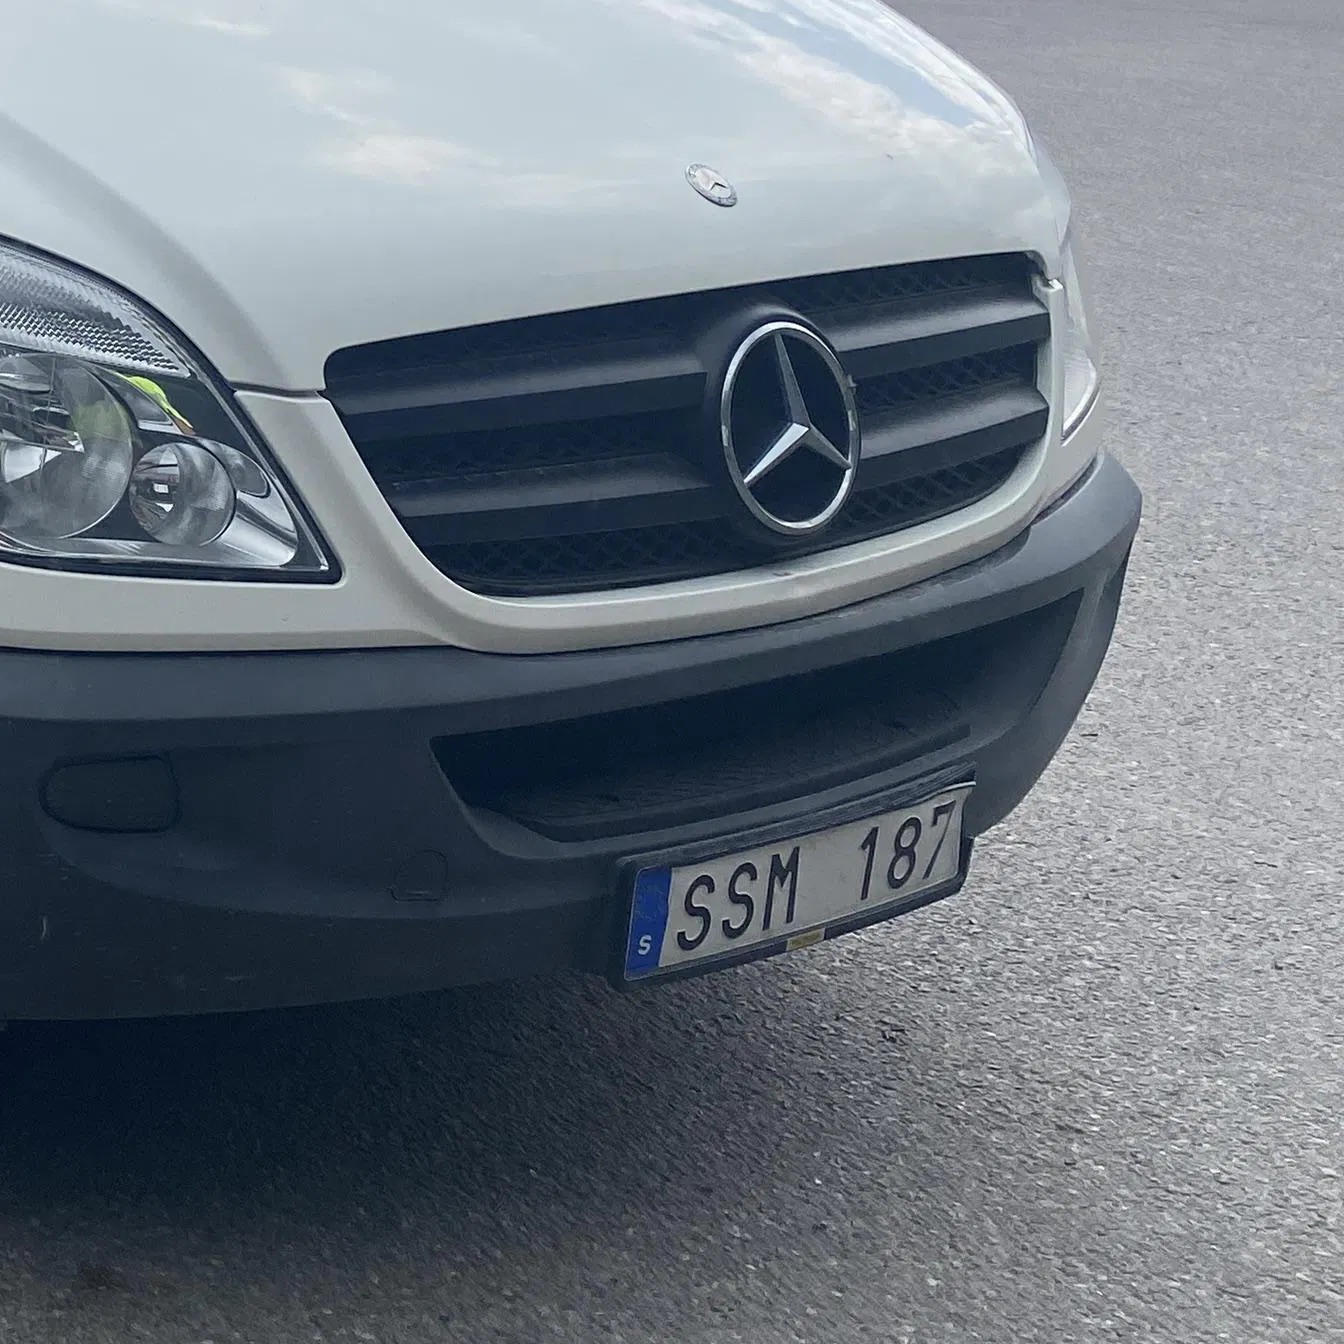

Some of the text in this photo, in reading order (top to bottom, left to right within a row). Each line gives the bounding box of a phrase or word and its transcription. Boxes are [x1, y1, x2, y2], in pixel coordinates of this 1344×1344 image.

[677, 800, 957, 951] SSM 187
[638, 934, 651, 956] S
